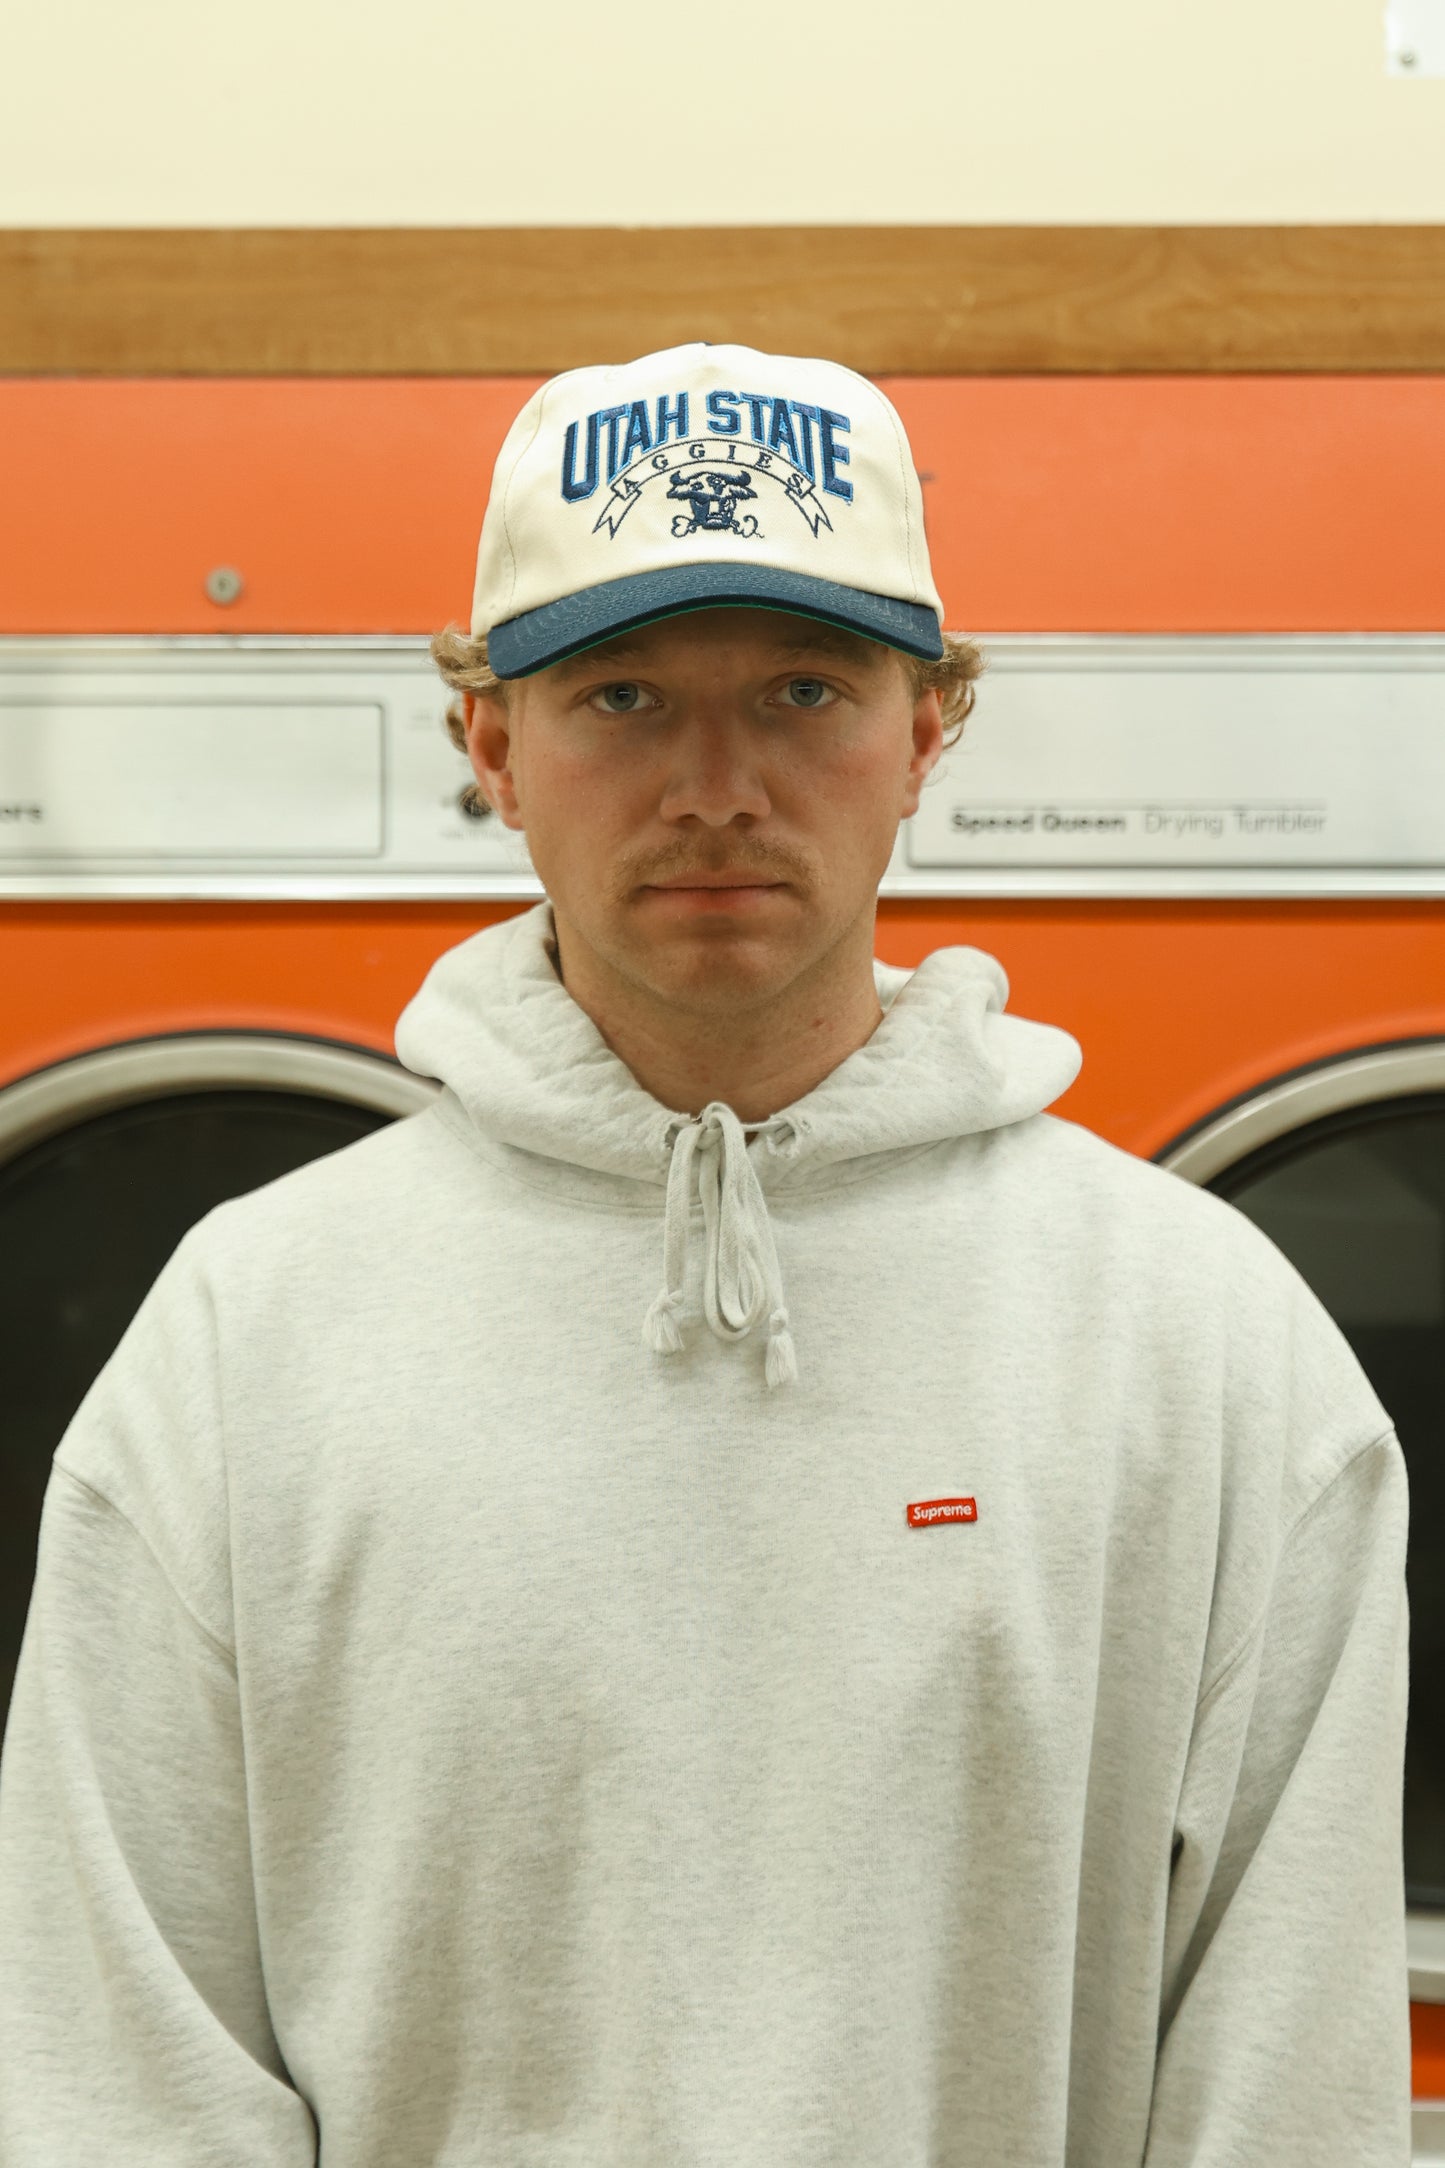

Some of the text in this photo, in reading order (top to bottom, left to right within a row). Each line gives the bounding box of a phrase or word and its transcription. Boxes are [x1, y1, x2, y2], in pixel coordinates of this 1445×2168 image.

[561, 390, 854, 504] UTAH STATE
[622, 443, 806, 500] AGGIES
[952, 804, 1327, 839] Speed Queen Drying Tumbler
[913, 1504, 972, 1521] Supreme
